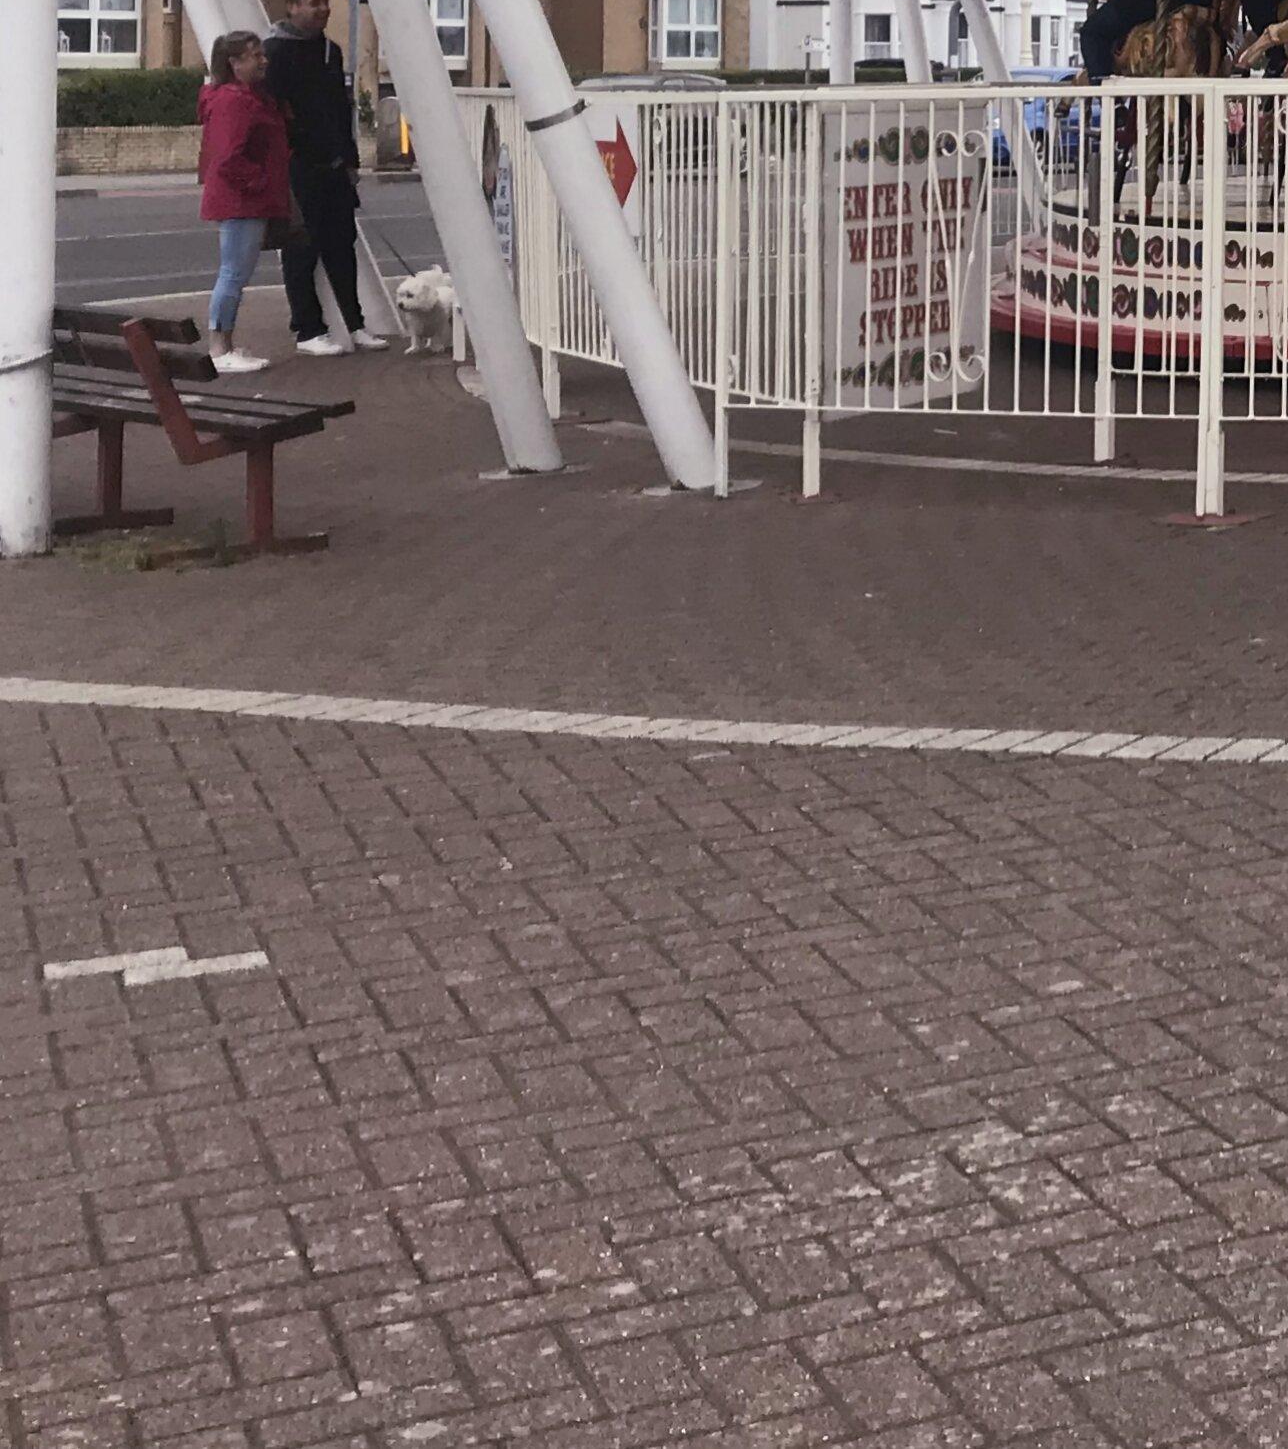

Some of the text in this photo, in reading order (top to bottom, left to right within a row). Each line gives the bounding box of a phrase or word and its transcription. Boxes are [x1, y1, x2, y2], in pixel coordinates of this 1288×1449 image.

[838, 181, 912, 221] ENTER
[847, 222, 914, 264] WHEN
[869, 263, 918, 303] RIDE
[858, 299, 952, 347] STOPPED
